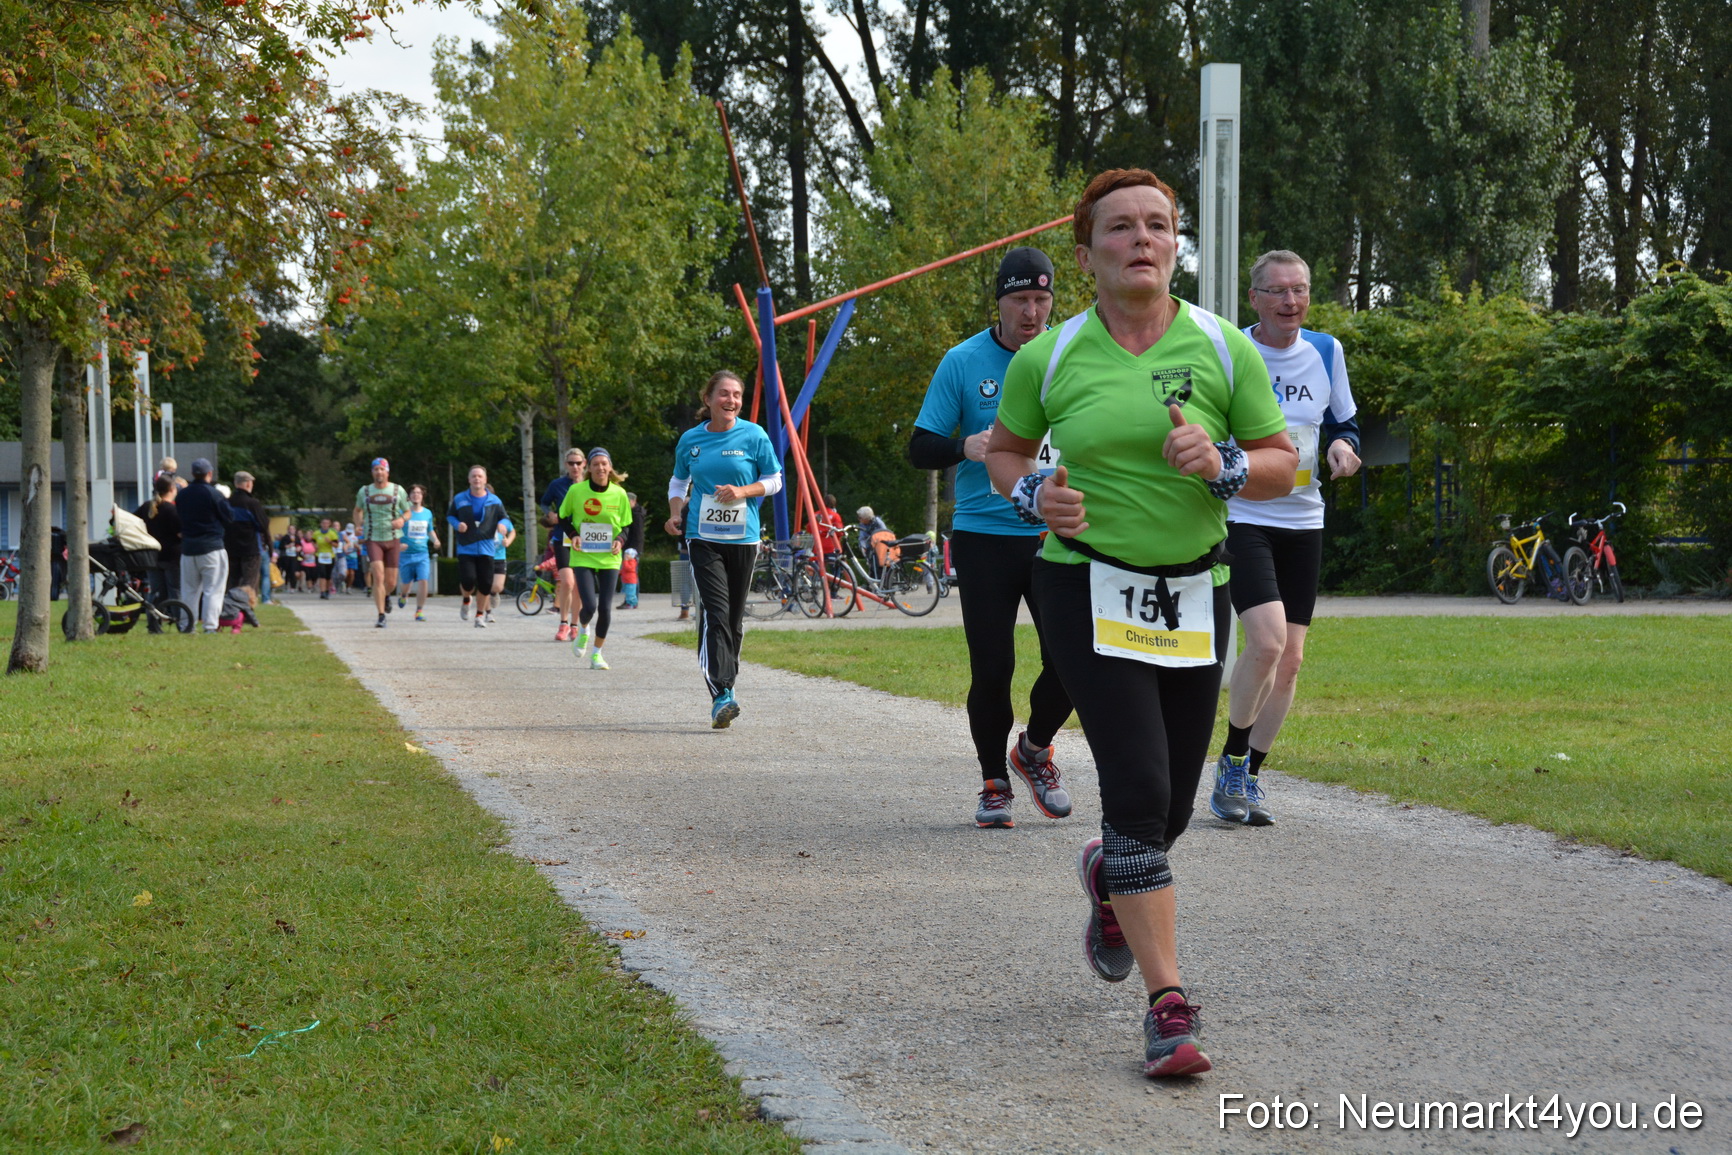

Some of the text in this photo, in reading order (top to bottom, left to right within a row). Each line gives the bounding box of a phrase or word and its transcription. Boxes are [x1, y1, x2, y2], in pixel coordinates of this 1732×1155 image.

[706, 508, 740, 523] 2367
[585, 531, 608, 541] 2905
[1126, 629, 1179, 648] Christine
